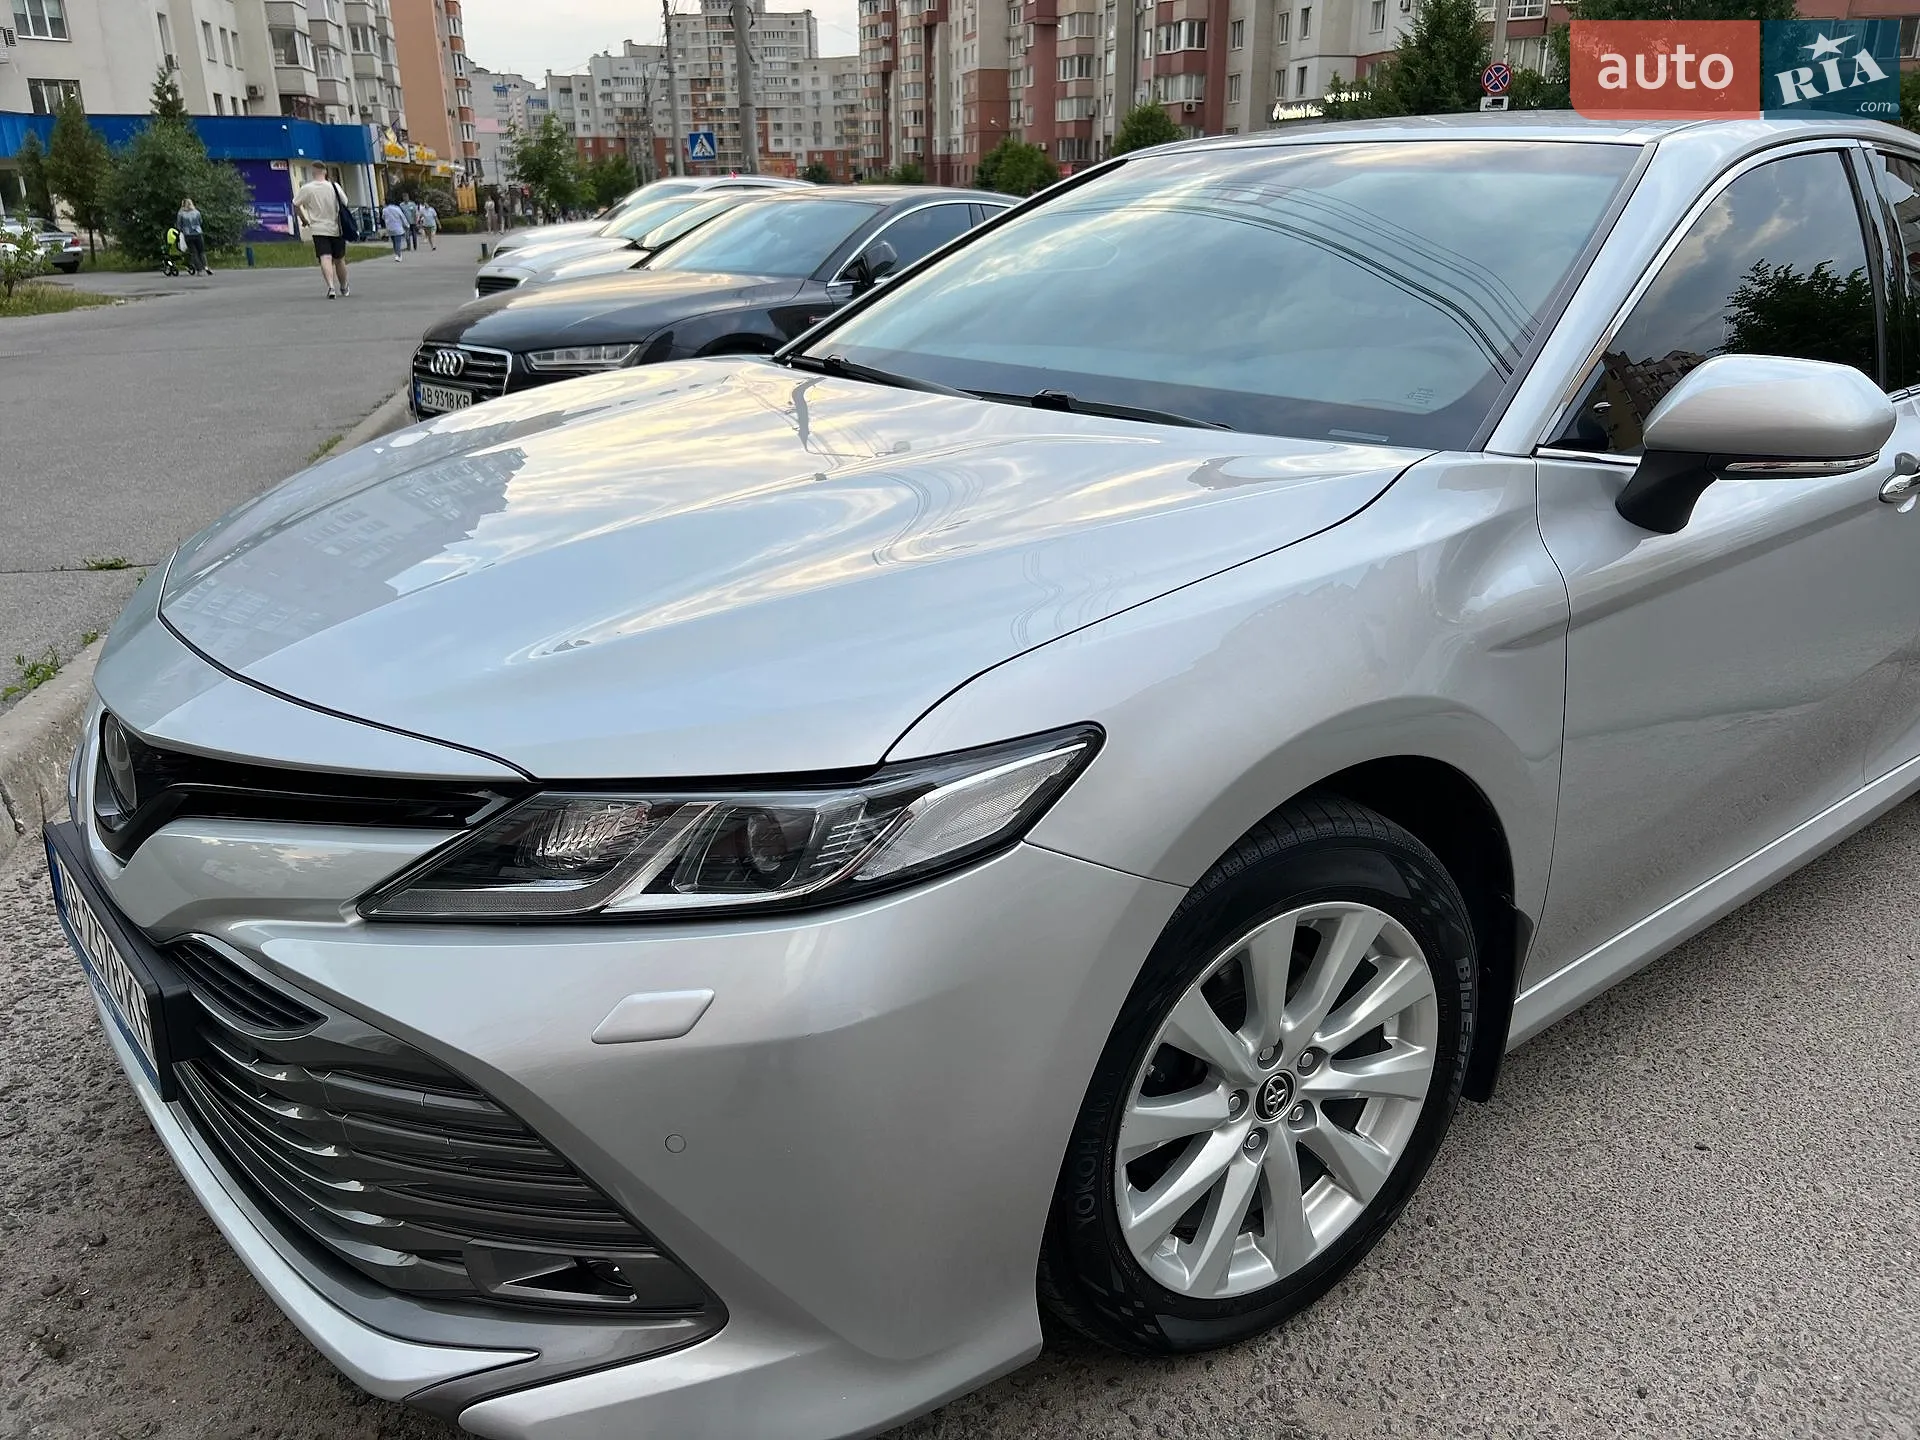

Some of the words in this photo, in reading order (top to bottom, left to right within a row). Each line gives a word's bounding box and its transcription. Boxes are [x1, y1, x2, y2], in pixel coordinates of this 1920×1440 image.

[422, 386, 433, 404] AB
[434, 389, 455, 409] 9318
[82, 899, 123, 1005] 2378
[120, 961, 155, 1057] KH
